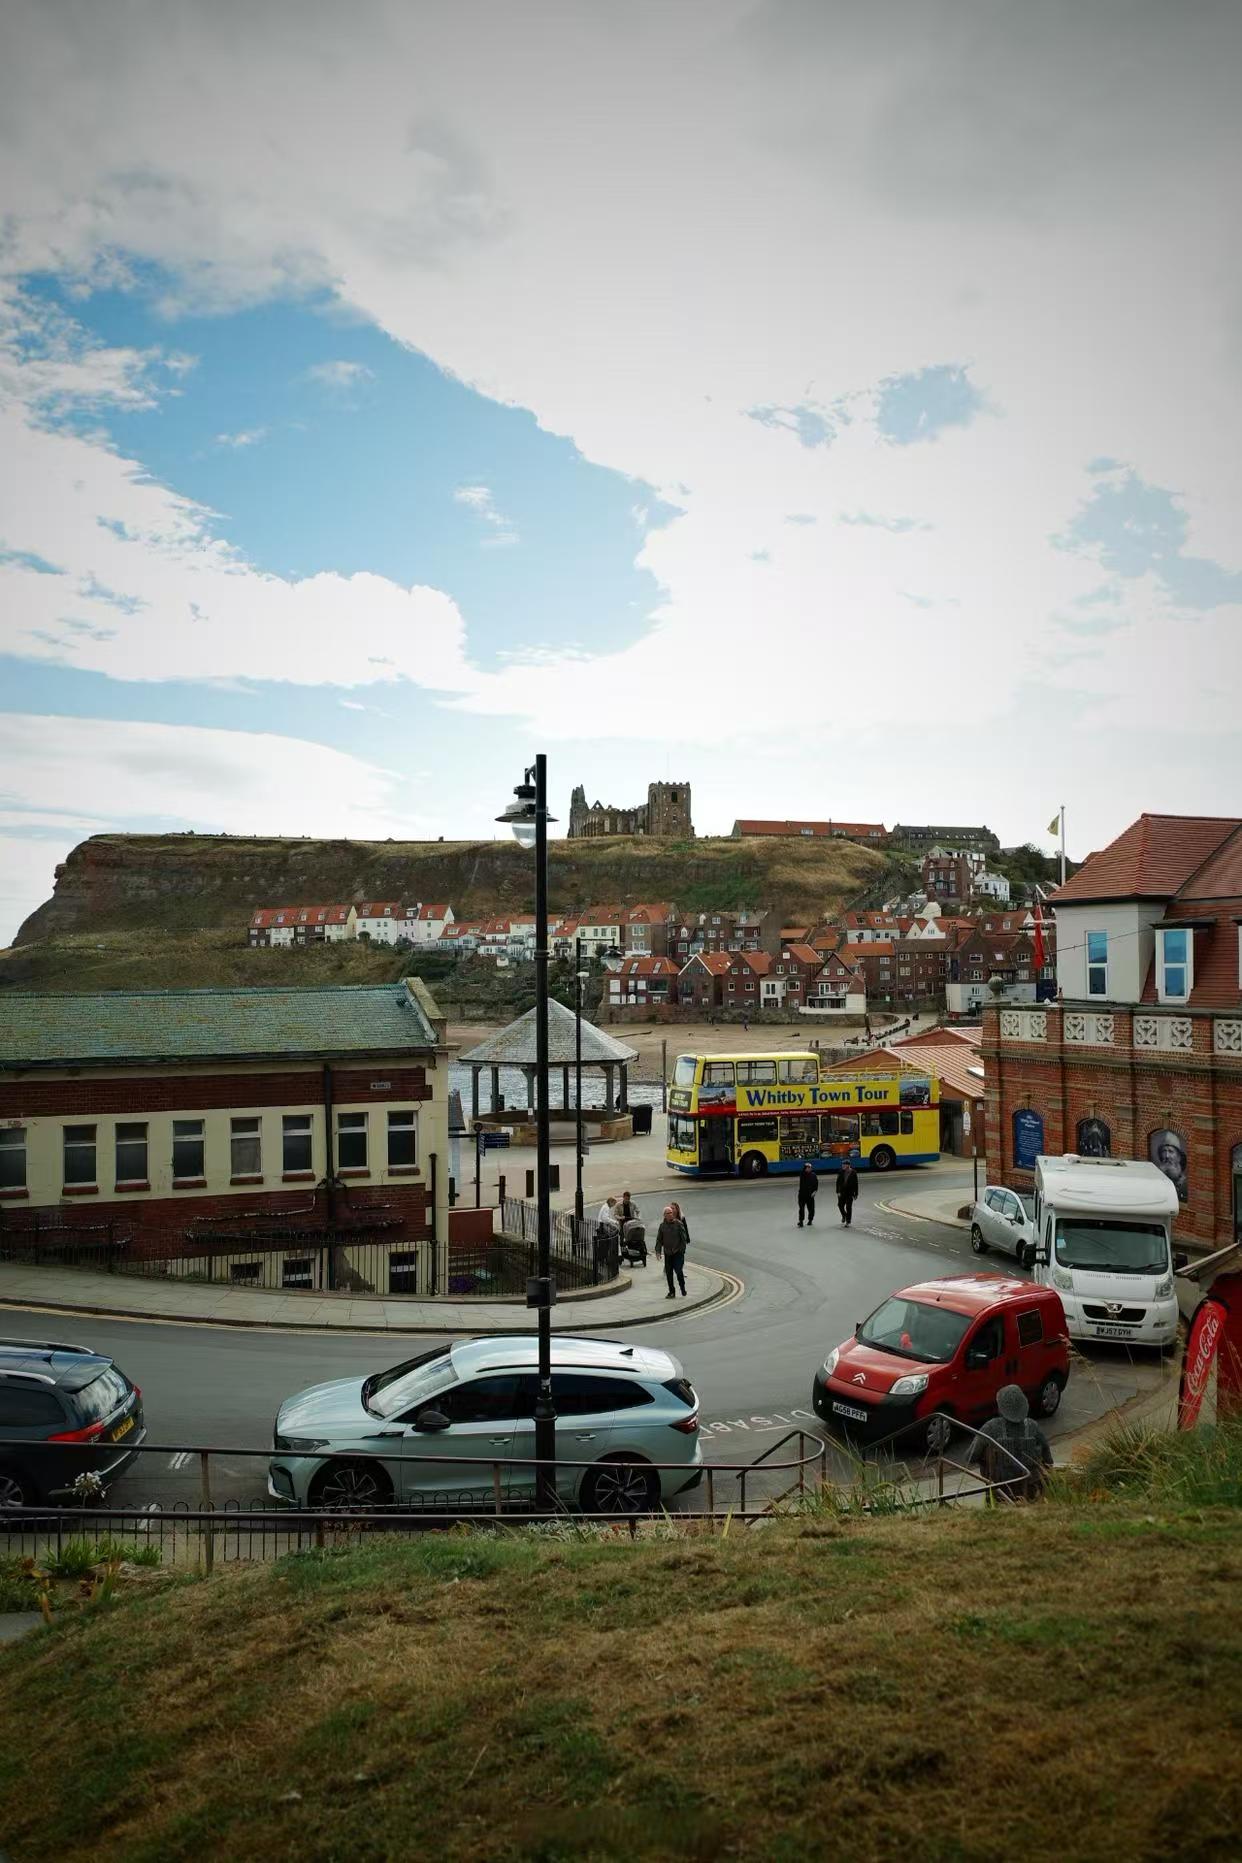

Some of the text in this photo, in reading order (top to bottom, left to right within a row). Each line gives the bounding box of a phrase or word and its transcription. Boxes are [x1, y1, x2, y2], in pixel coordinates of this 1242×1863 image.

[745, 1085, 889, 1107] Whitby Town Tour
